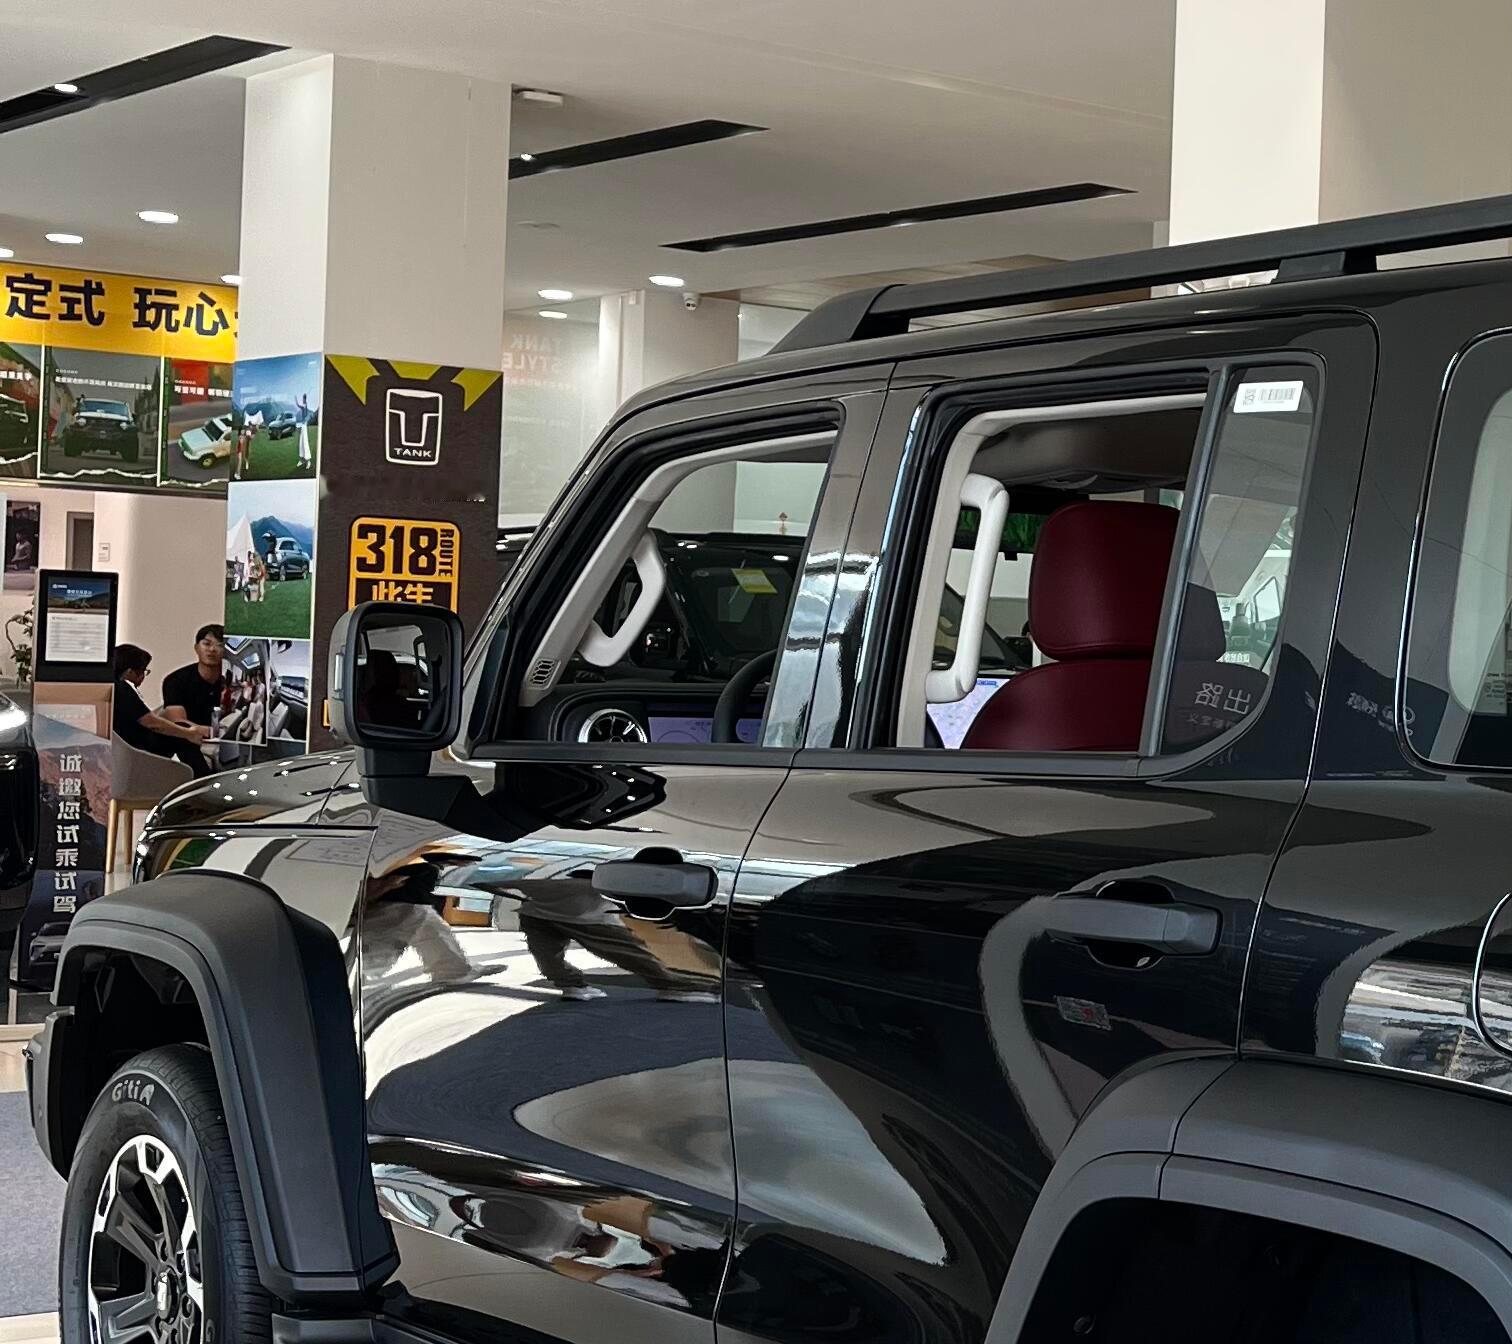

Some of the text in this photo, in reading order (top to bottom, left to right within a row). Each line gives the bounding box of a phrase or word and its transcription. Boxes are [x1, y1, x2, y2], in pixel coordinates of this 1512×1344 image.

[6, 273, 239, 338] 定式 玩心
[393, 447, 433, 458] TANK
[356, 524, 438, 576] 318
[439, 528, 455, 578] ROUTE
[53, 753, 82, 913] 诚邀您试乘试驾
